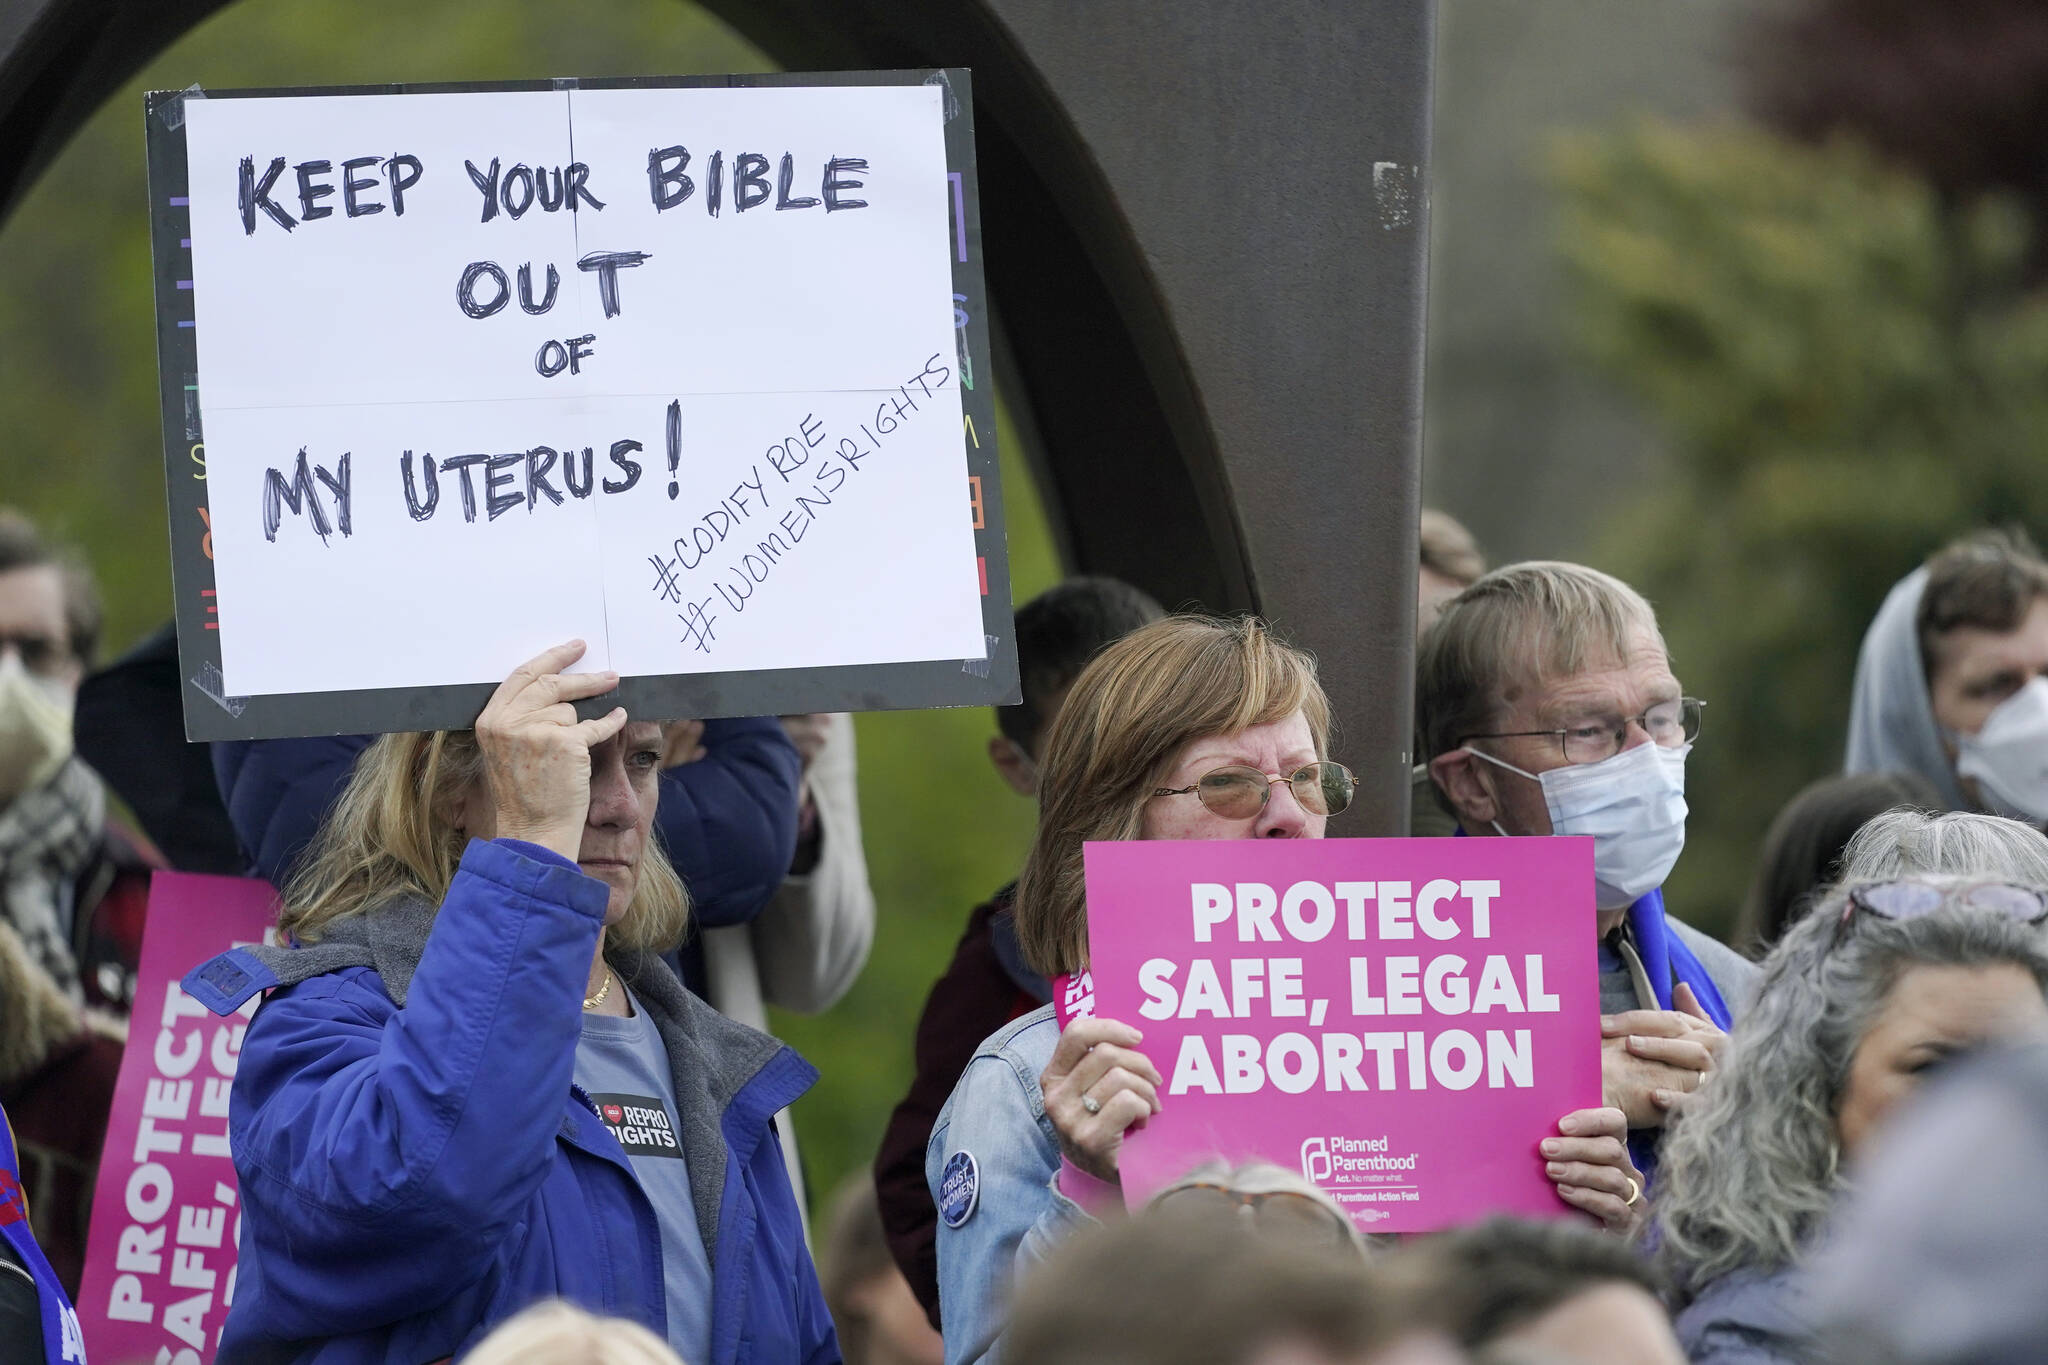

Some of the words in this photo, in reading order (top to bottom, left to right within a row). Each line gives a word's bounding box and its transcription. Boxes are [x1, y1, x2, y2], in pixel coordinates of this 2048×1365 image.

[239, 154, 424, 236] KEEP
[464, 156, 606, 223] YOUR
[647, 145, 870, 218] BIBLE
[456, 251, 653, 320] OUT
[535, 334, 596, 378] OF
[264, 446, 352, 547] MY
[648, 466, 769, 604] #CODIFY
[767, 414, 826, 482] ROE
[678, 353, 950, 653] #WOMENSRIGHTS
[1190, 879, 1501, 943] PROTECT
[1138, 957, 1329, 1026] SAFE,
[1350, 954, 1560, 1016] LEGAL
[1169, 1029, 1534, 1095] ABORTION
[623, 1106, 669, 1129] REPRO
[1330, 1135, 1389, 1153] Planned
[108, 980, 212, 1323] PROTECT
[943, 1166, 969, 1195] TRUST
[940, 1178, 975, 1213] WOMEN
